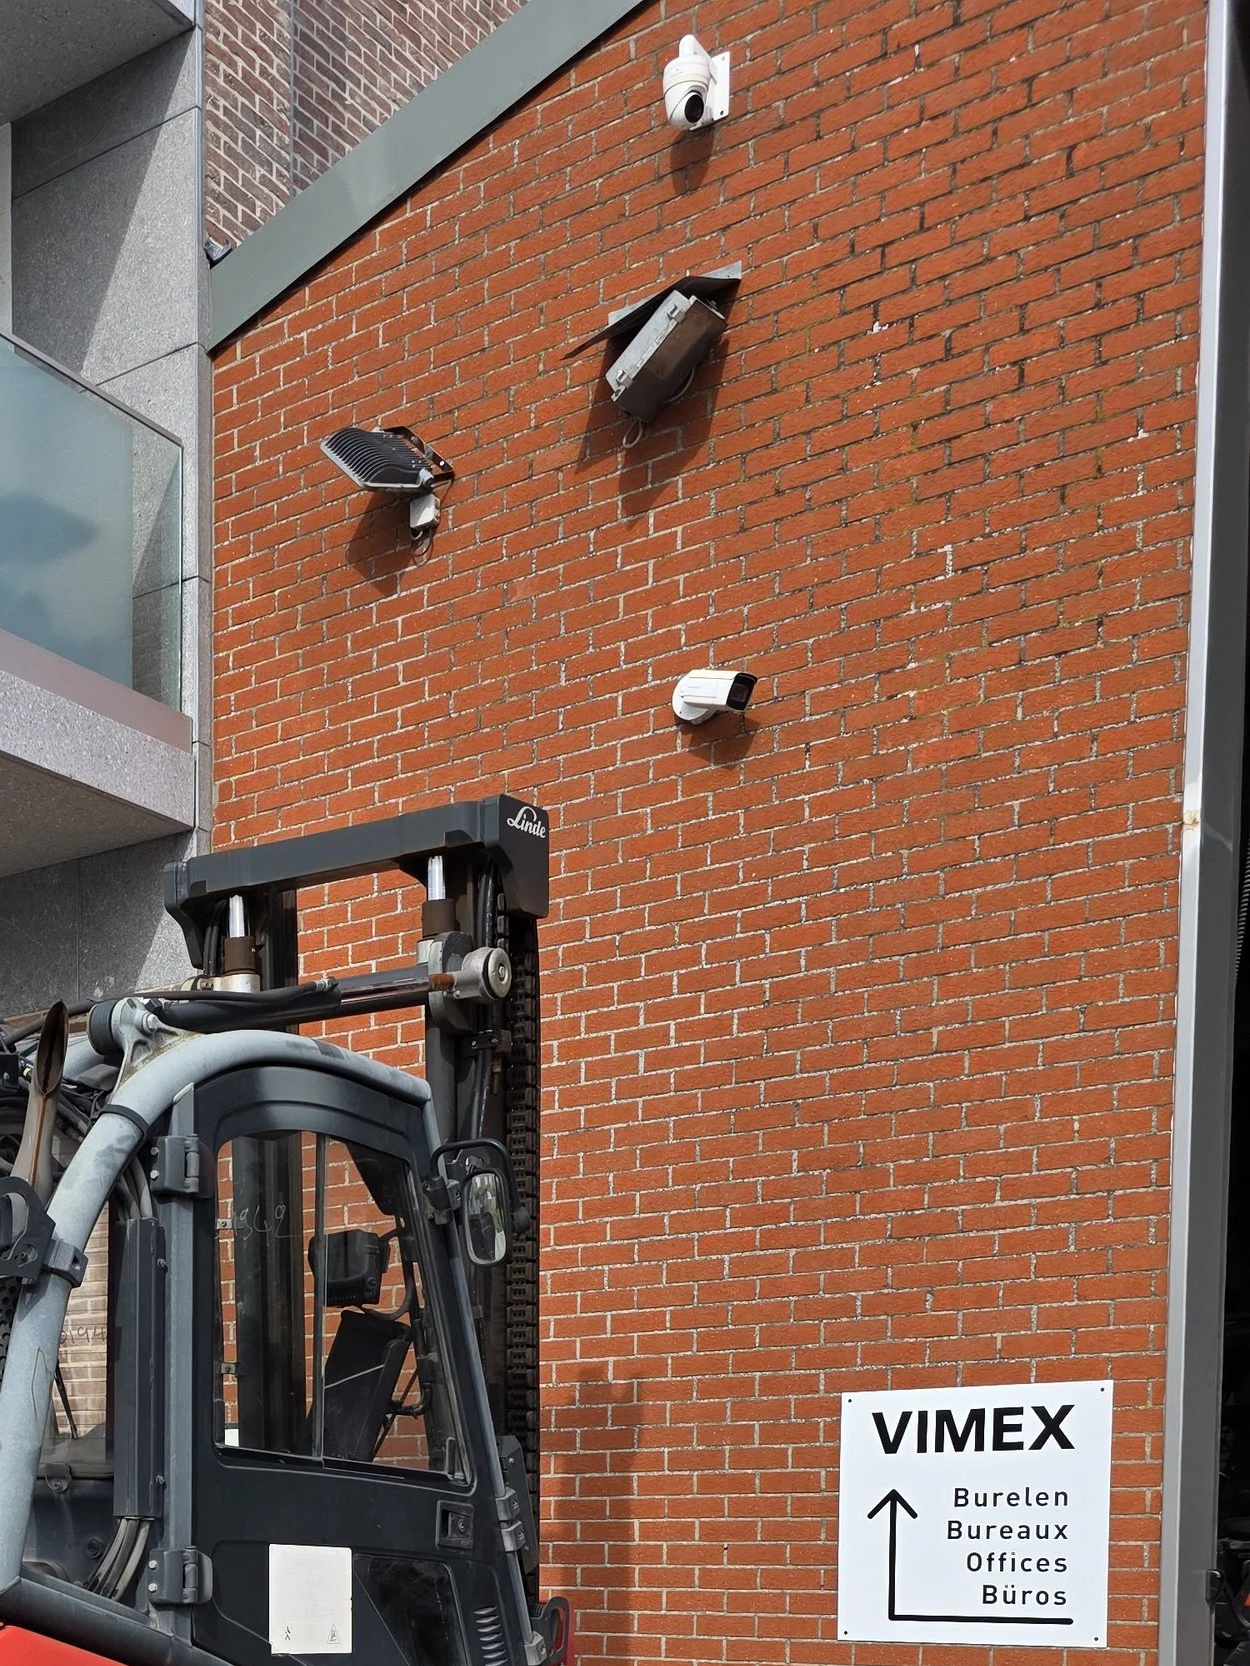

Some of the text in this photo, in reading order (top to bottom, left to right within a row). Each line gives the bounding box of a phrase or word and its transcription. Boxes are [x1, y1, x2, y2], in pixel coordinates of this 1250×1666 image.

[507, 806, 546, 838] Linde
[872, 1404, 1076, 1454] VIMEX
[953, 1486, 1069, 1508] Burelen
[946, 1519, 1069, 1541] Bureaux
[966, 1552, 1068, 1573] Offices
[981, 1584, 1067, 1605] Büros
